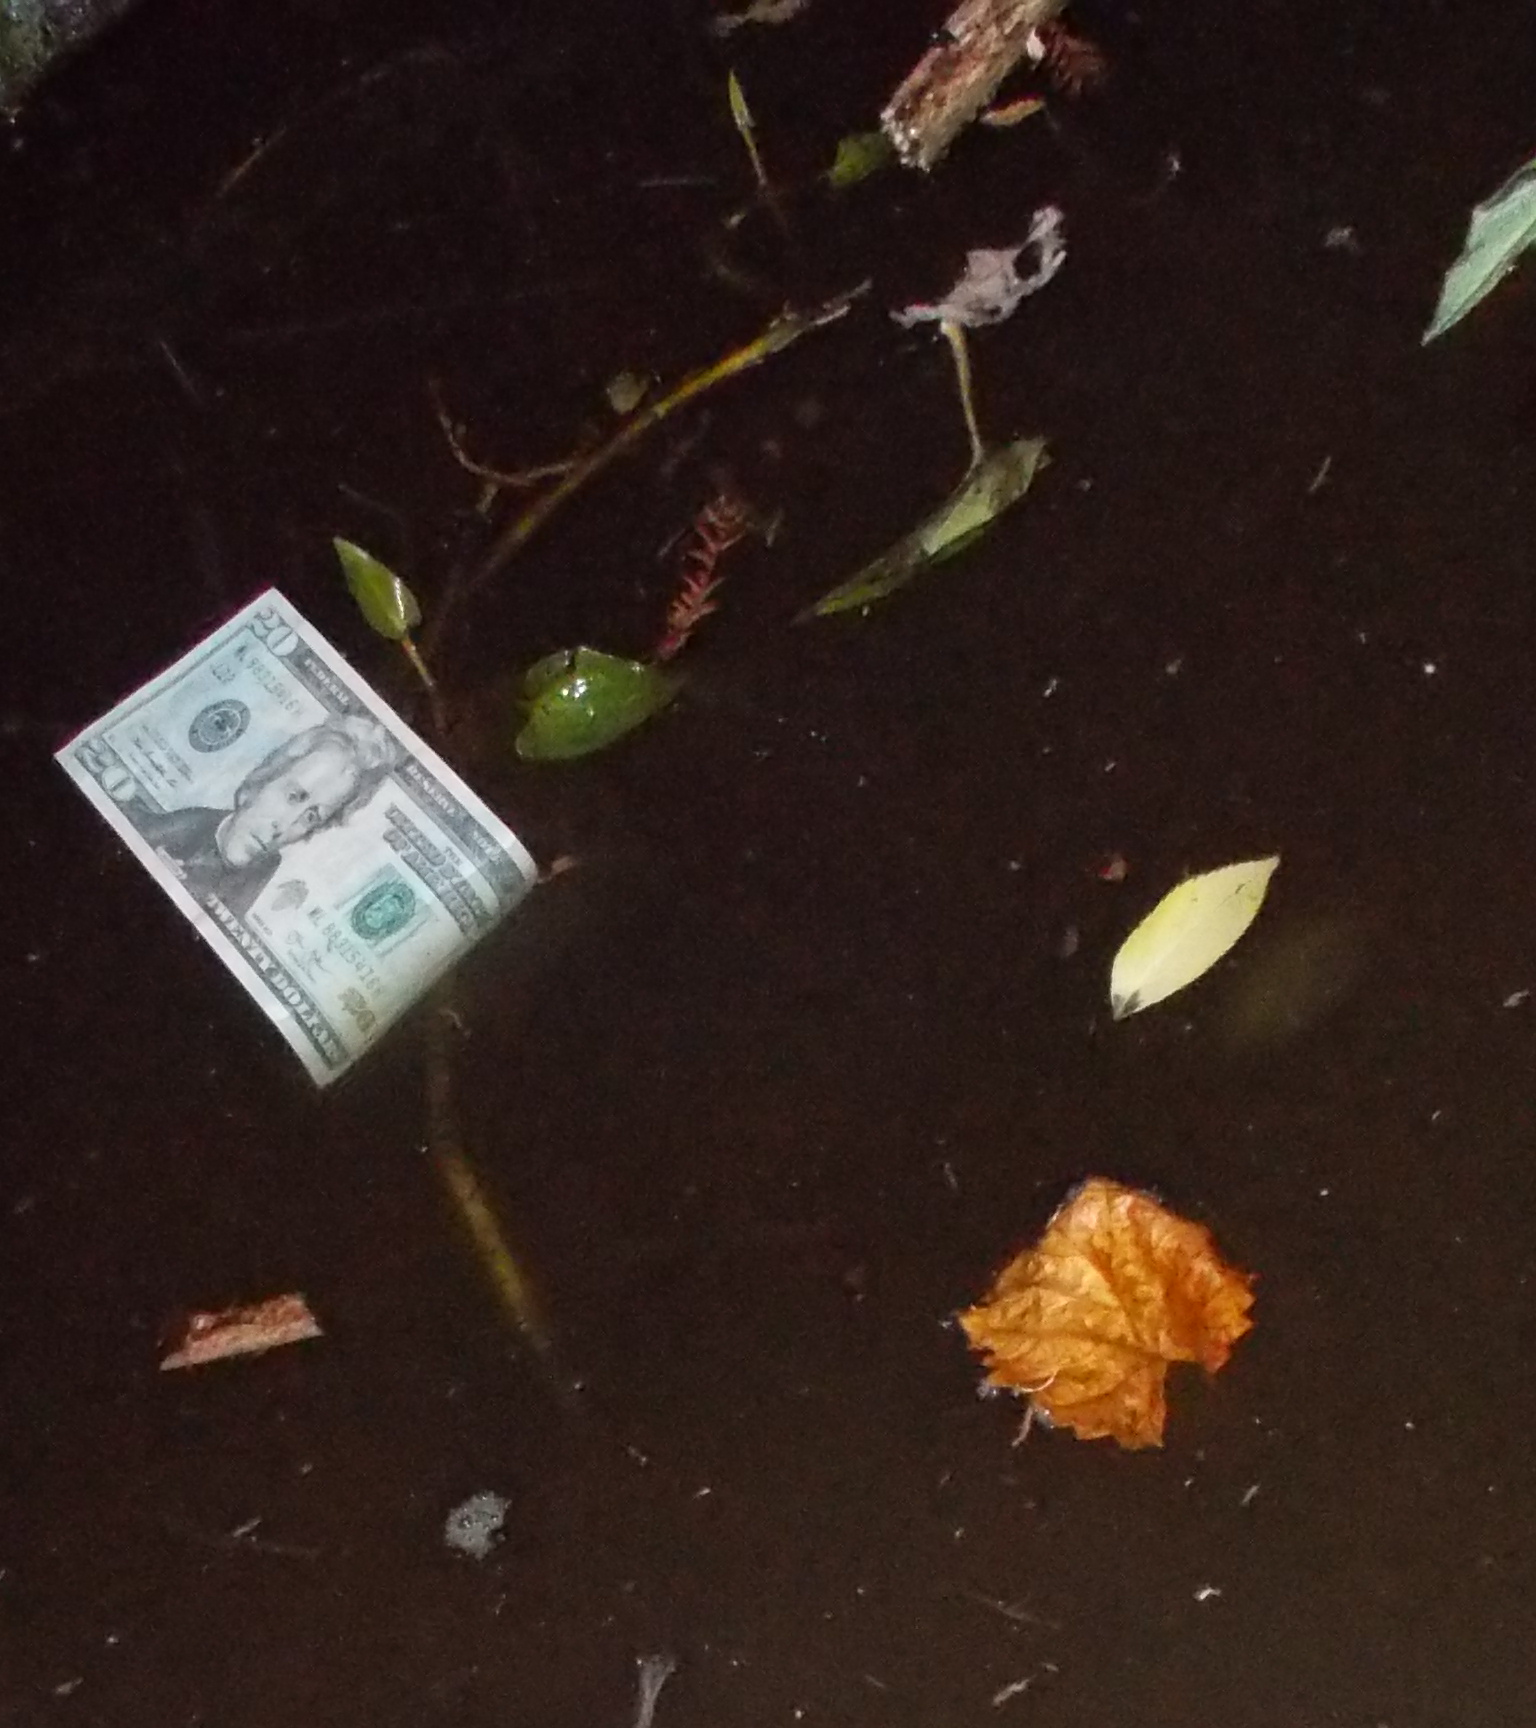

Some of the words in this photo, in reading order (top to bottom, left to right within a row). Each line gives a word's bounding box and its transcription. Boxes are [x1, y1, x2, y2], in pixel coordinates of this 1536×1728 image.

[250, 608, 299, 656] 20
[78, 739, 137, 804] 20
[204, 891, 277, 972] TWENTY
